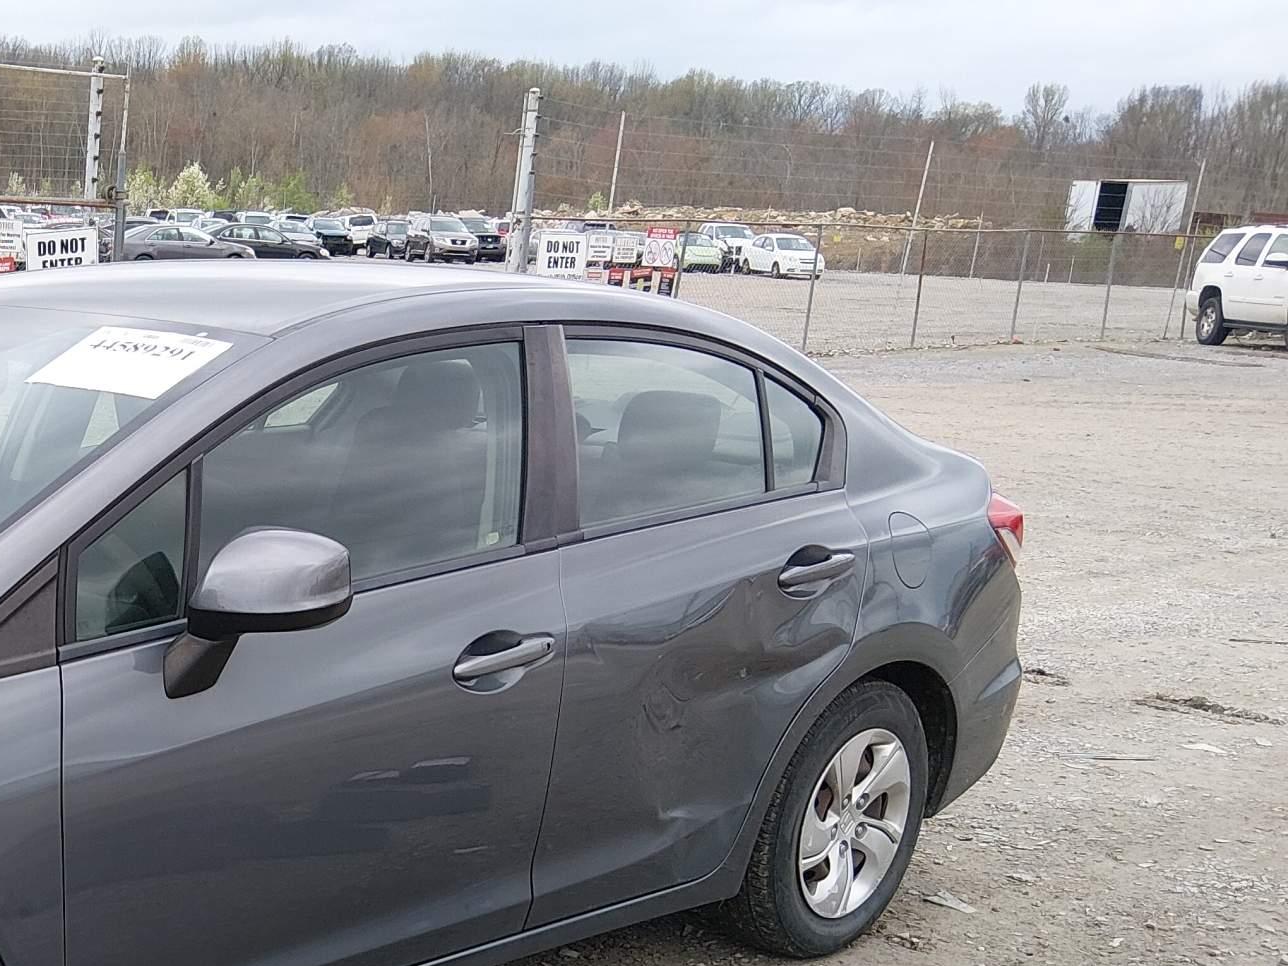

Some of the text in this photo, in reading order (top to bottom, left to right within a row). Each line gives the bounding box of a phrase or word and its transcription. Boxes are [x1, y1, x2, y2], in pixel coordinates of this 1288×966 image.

[37, 237, 87, 257] DO NOT
[546, 241, 560, 253] DO
[562, 240, 581, 254] NOT
[547, 256, 576, 269] ENTER
